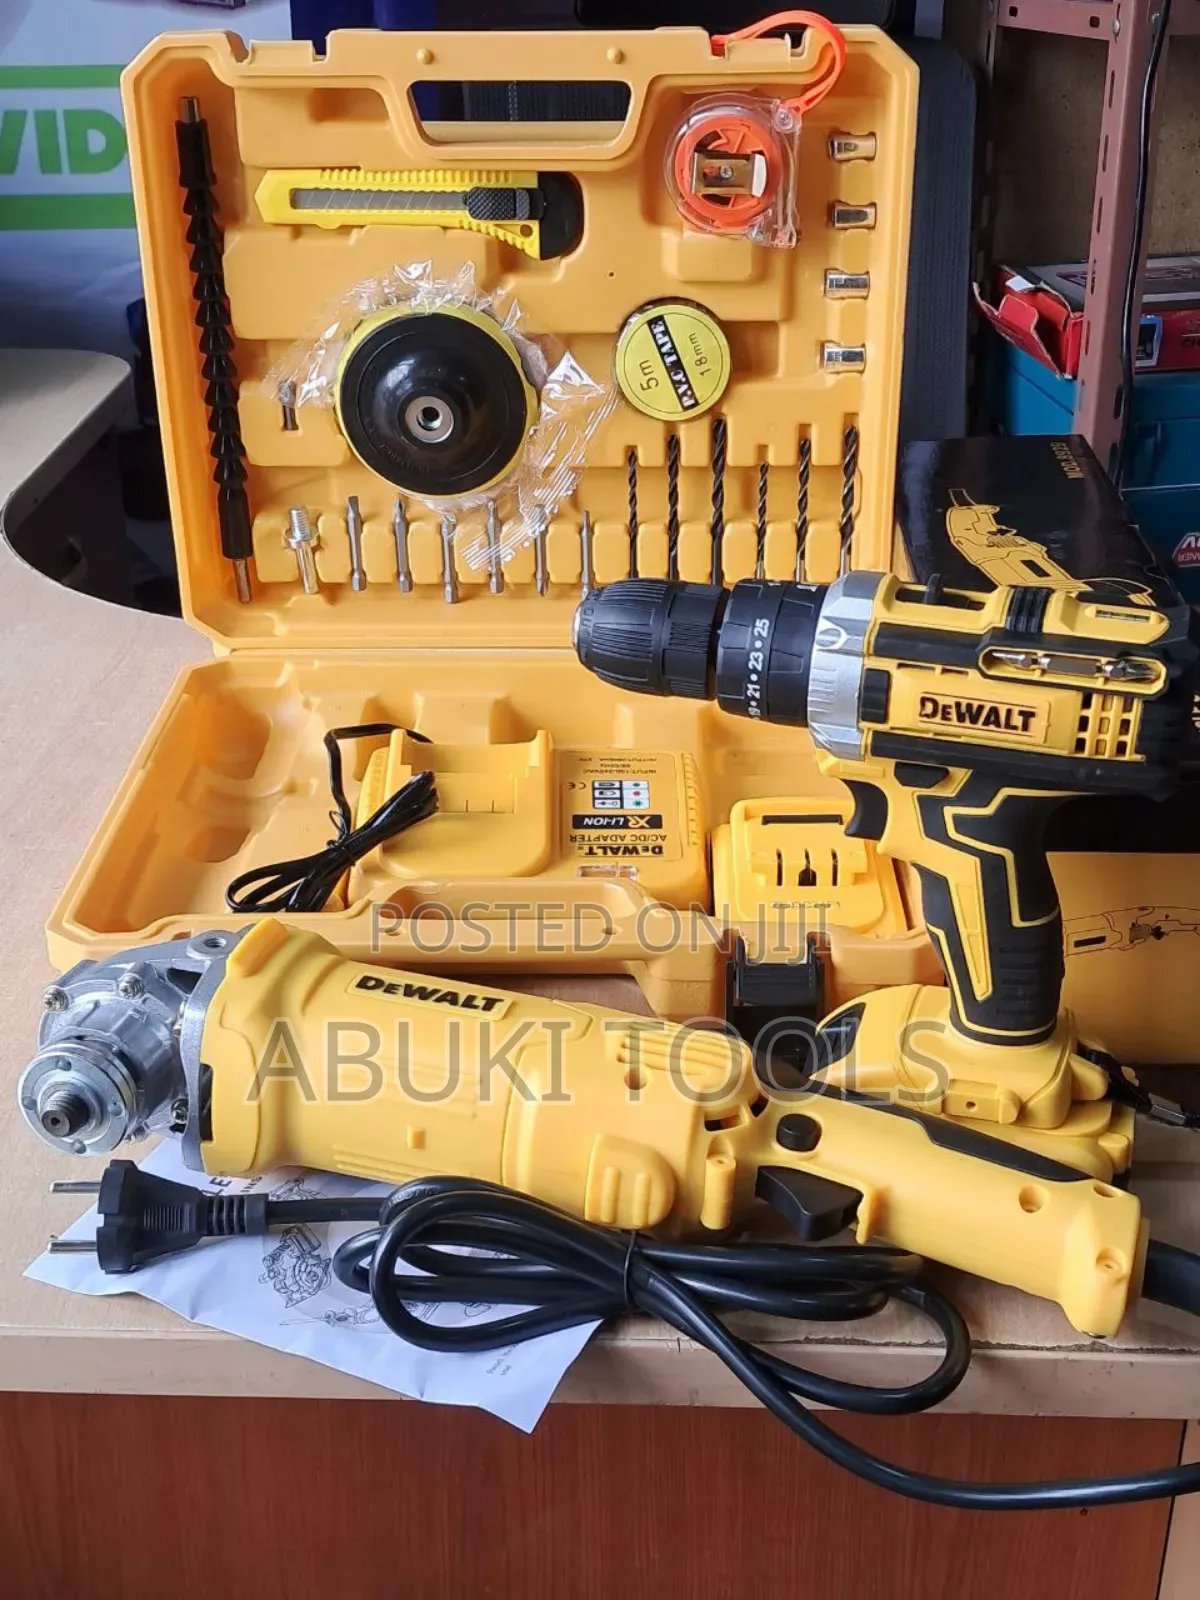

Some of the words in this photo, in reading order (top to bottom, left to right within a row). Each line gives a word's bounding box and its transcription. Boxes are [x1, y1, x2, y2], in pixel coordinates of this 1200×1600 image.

[651, 320, 678, 367] TAPE
[688, 332, 712, 377] 18mm
[639, 359, 660, 391] 5m
[753, 618, 770, 638] 25
[748, 651, 764, 672] 23
[747, 683, 761, 700] 21
[627, 816, 650, 828] XR
[569, 834, 627, 843] ADAPTER
[628, 834, 667, 842] AC/DC
